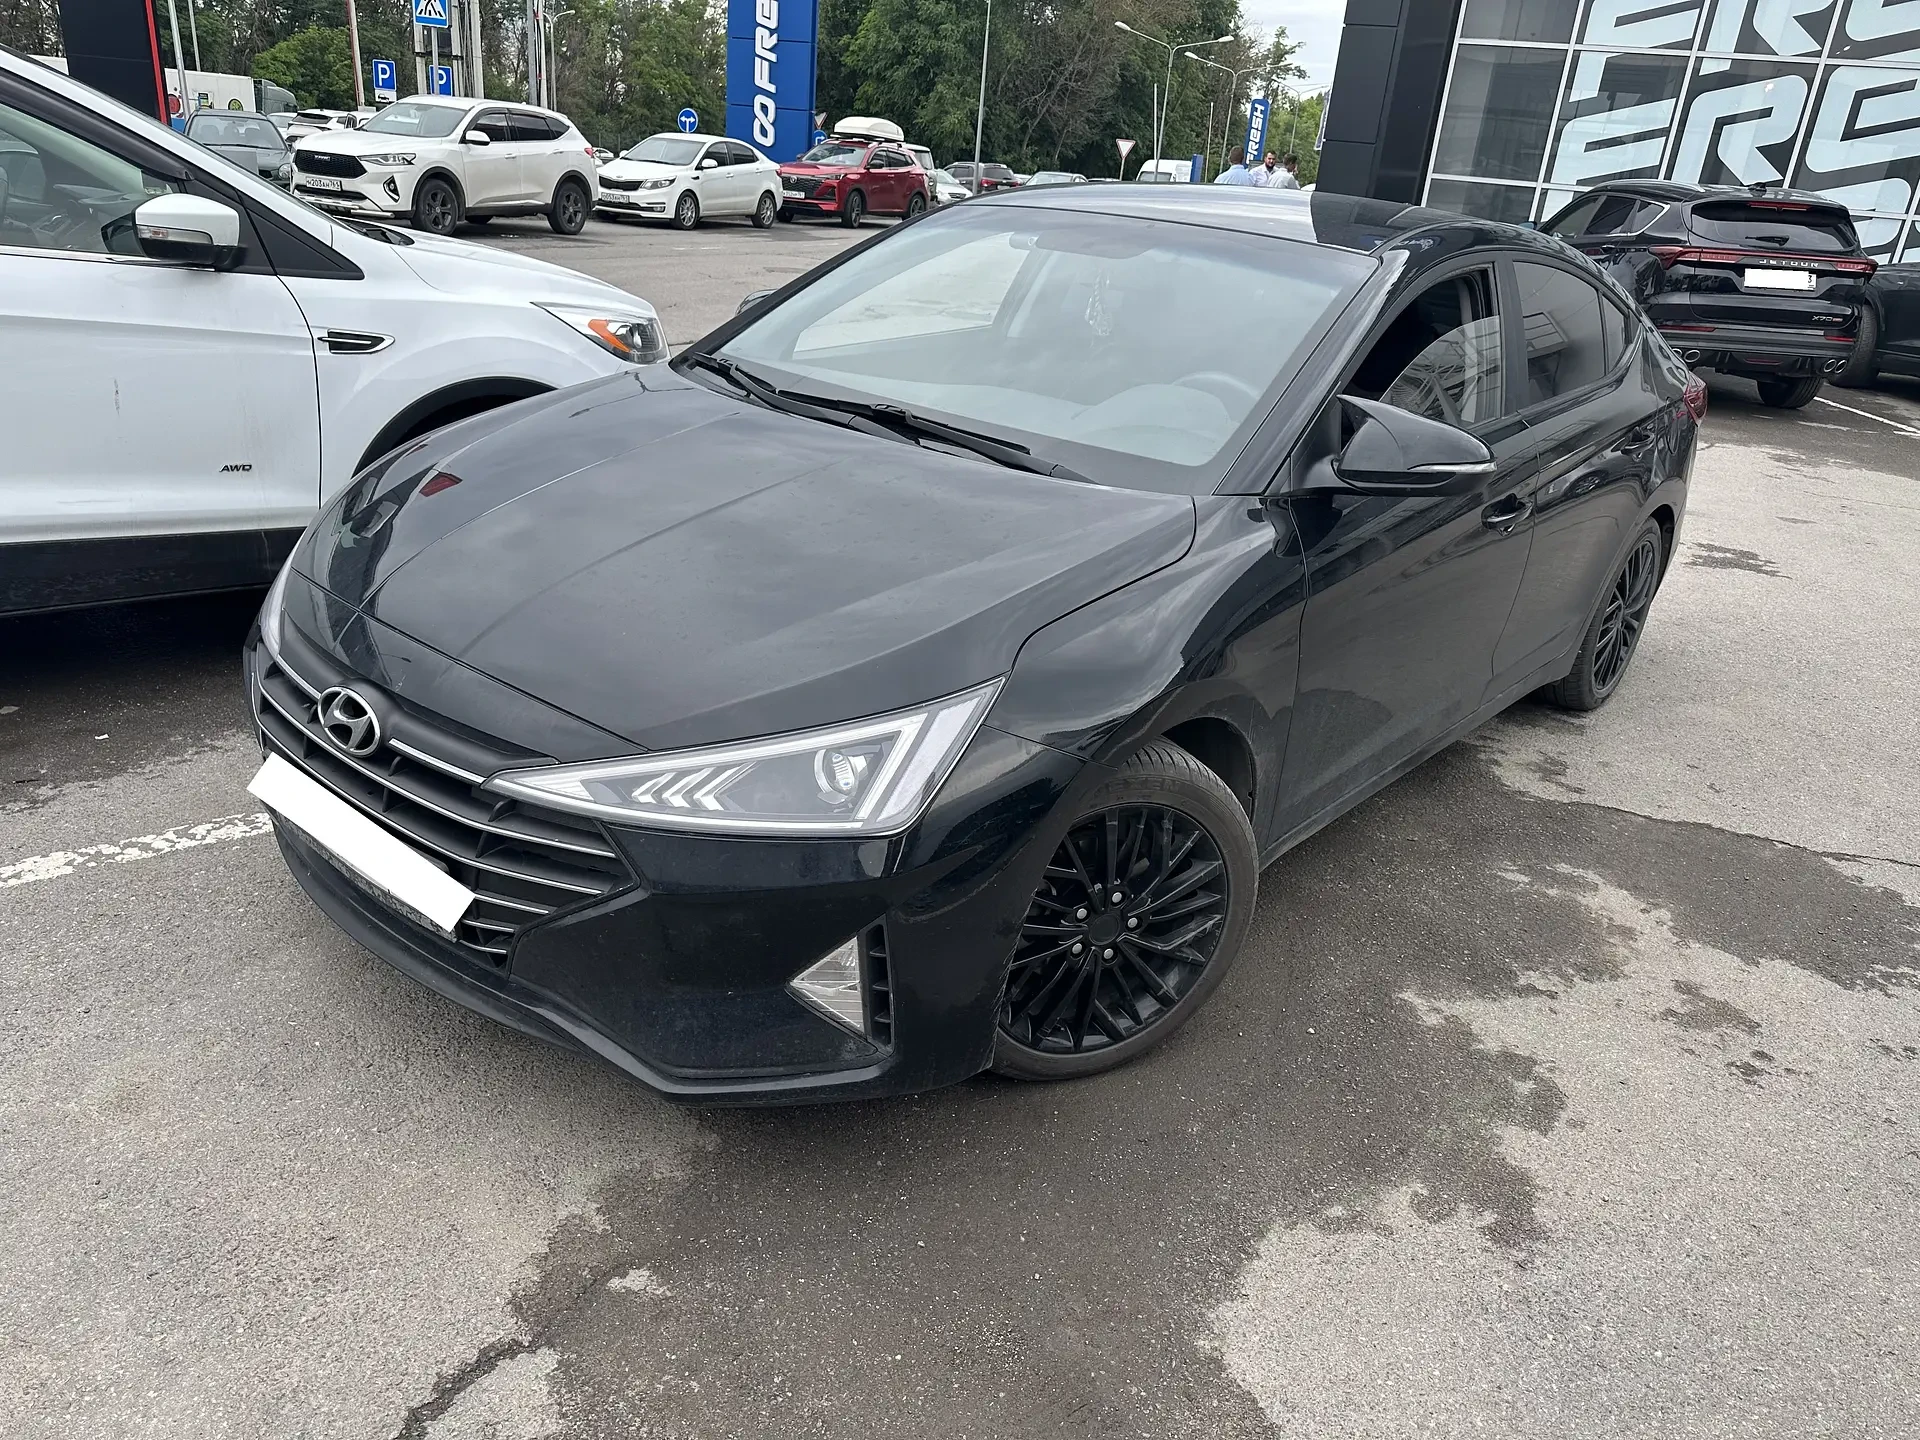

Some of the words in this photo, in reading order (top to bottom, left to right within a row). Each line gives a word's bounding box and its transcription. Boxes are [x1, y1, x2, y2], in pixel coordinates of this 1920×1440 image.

[378, 64, 390, 86] P
[1759, 259, 1818, 267] JETOUR
[219, 464, 253, 473] AWD
